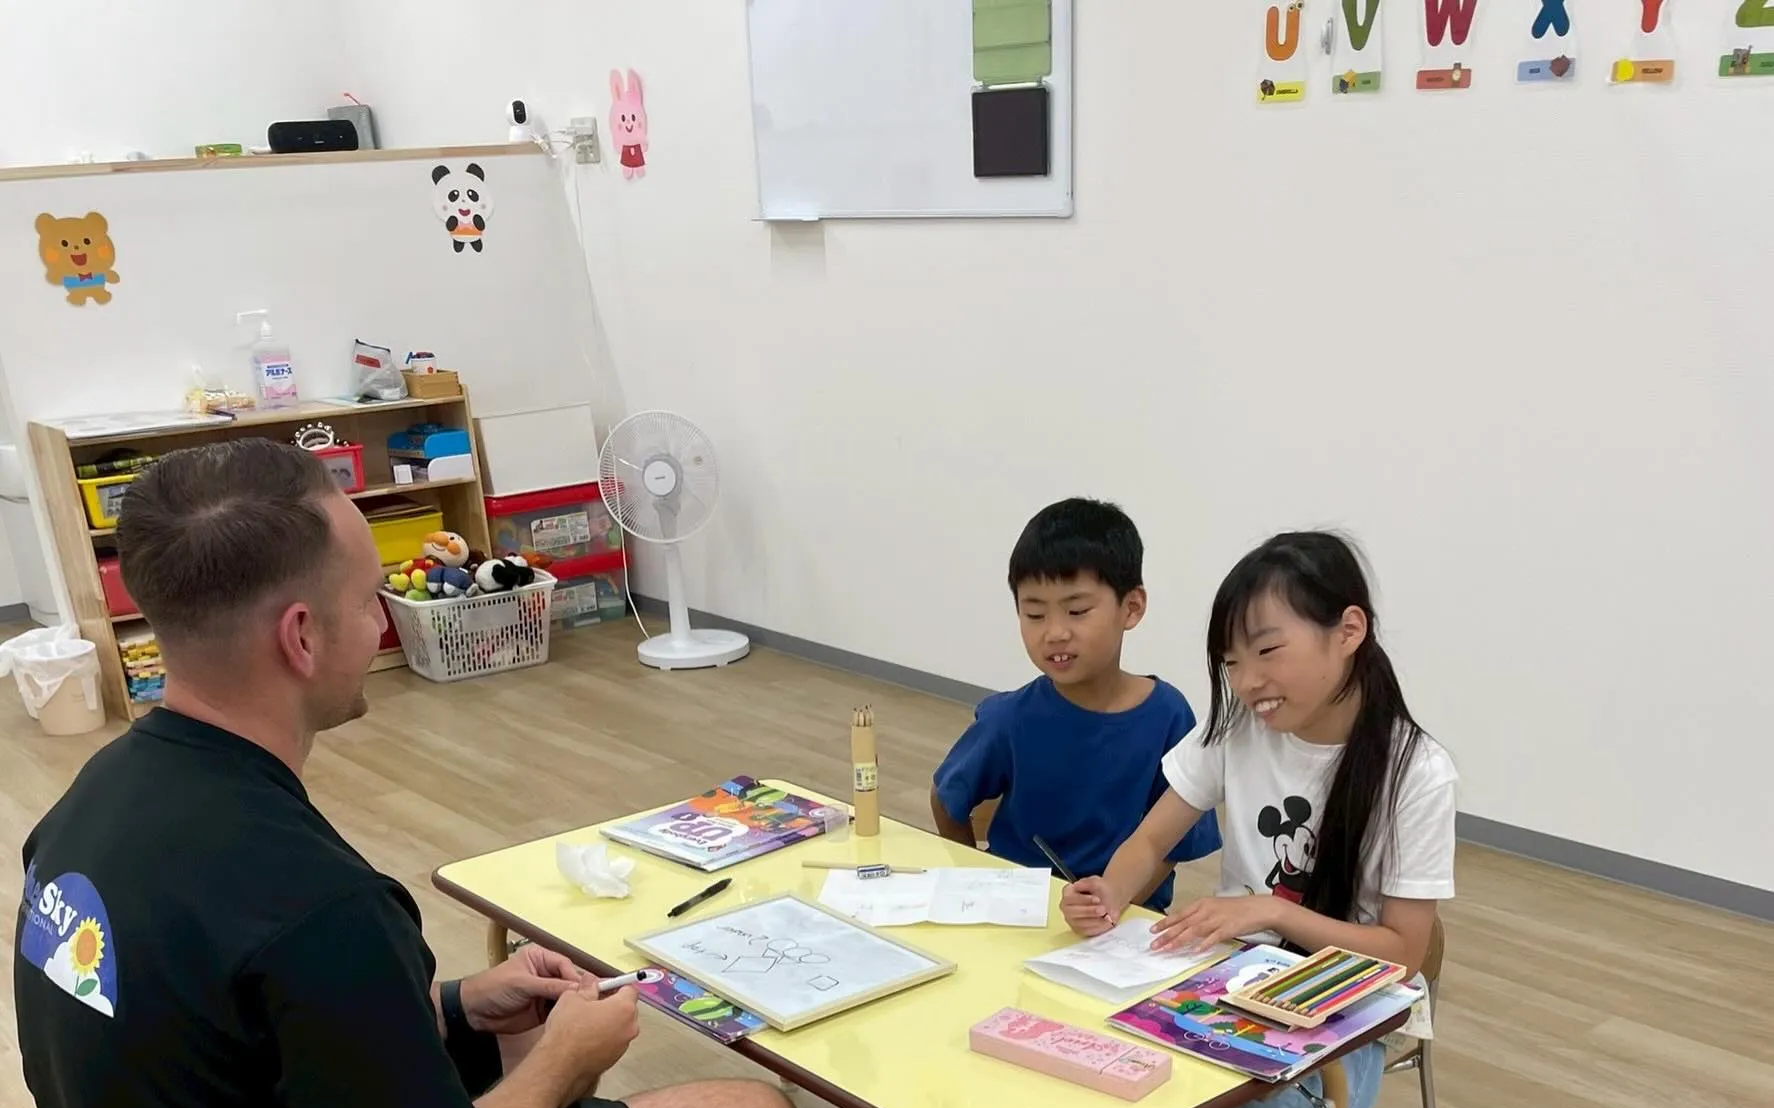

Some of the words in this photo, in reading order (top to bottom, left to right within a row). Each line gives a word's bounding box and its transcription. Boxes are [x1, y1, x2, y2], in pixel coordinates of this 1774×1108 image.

[1265, 6, 1300, 61] U
[1341, 0, 1380, 51] V
[1424, 0, 1478, 47] W
[38, 881, 78, 937] Sky
